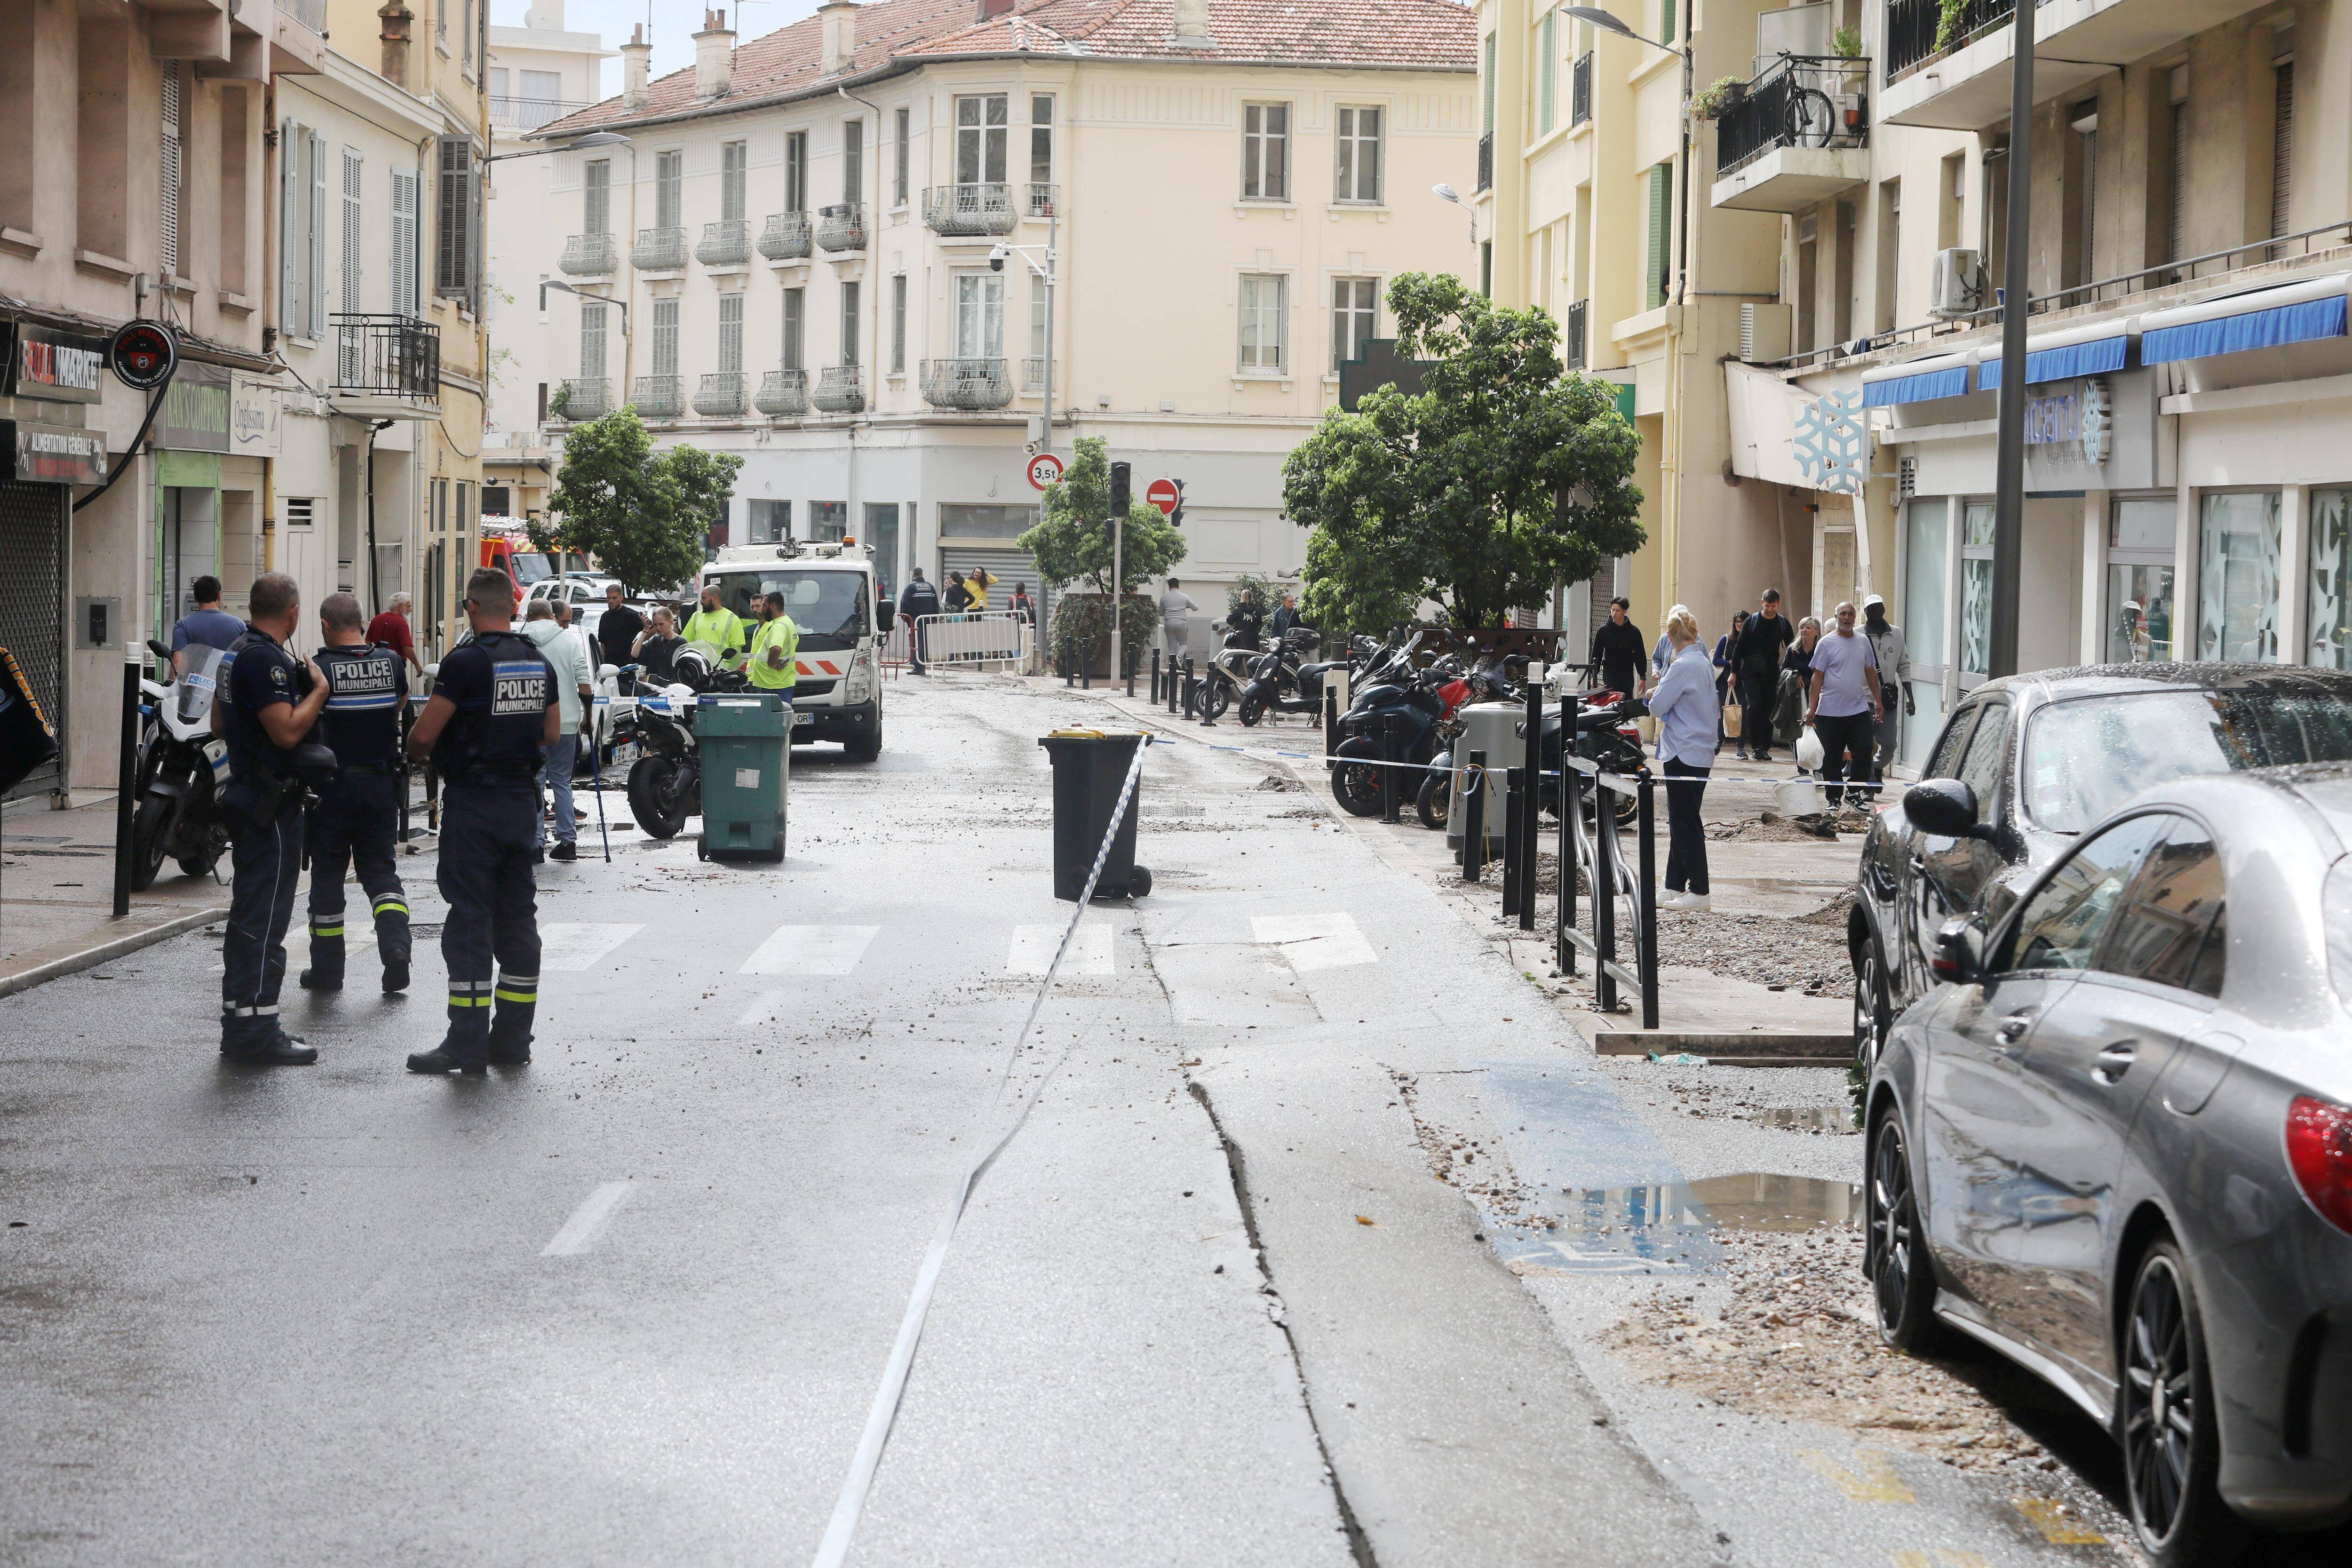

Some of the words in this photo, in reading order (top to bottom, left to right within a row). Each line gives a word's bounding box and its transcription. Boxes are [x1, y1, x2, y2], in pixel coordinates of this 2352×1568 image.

[56, 345, 103, 390] MARKET
[118, 361, 141, 383] ALIMENTATION
[154, 364, 167, 379] 24h/24h
[167, 382, 189, 429] KAN'S
[191, 385, 227, 432] COIFFURE
[2024, 379, 2078, 444] icard
[235, 400, 264, 438] Onglissima
[32, 432, 67, 454] ALIMENTATION
[68, 432, 91, 456] GÉNÉRALE
[189, 675, 215, 687] POLICE
[335, 661, 390, 679] POLICE
[337, 677, 392, 690] MUNICIPALE
[497, 679, 545, 700] POLICE
[496, 699, 544, 712] MUNICIPALE
